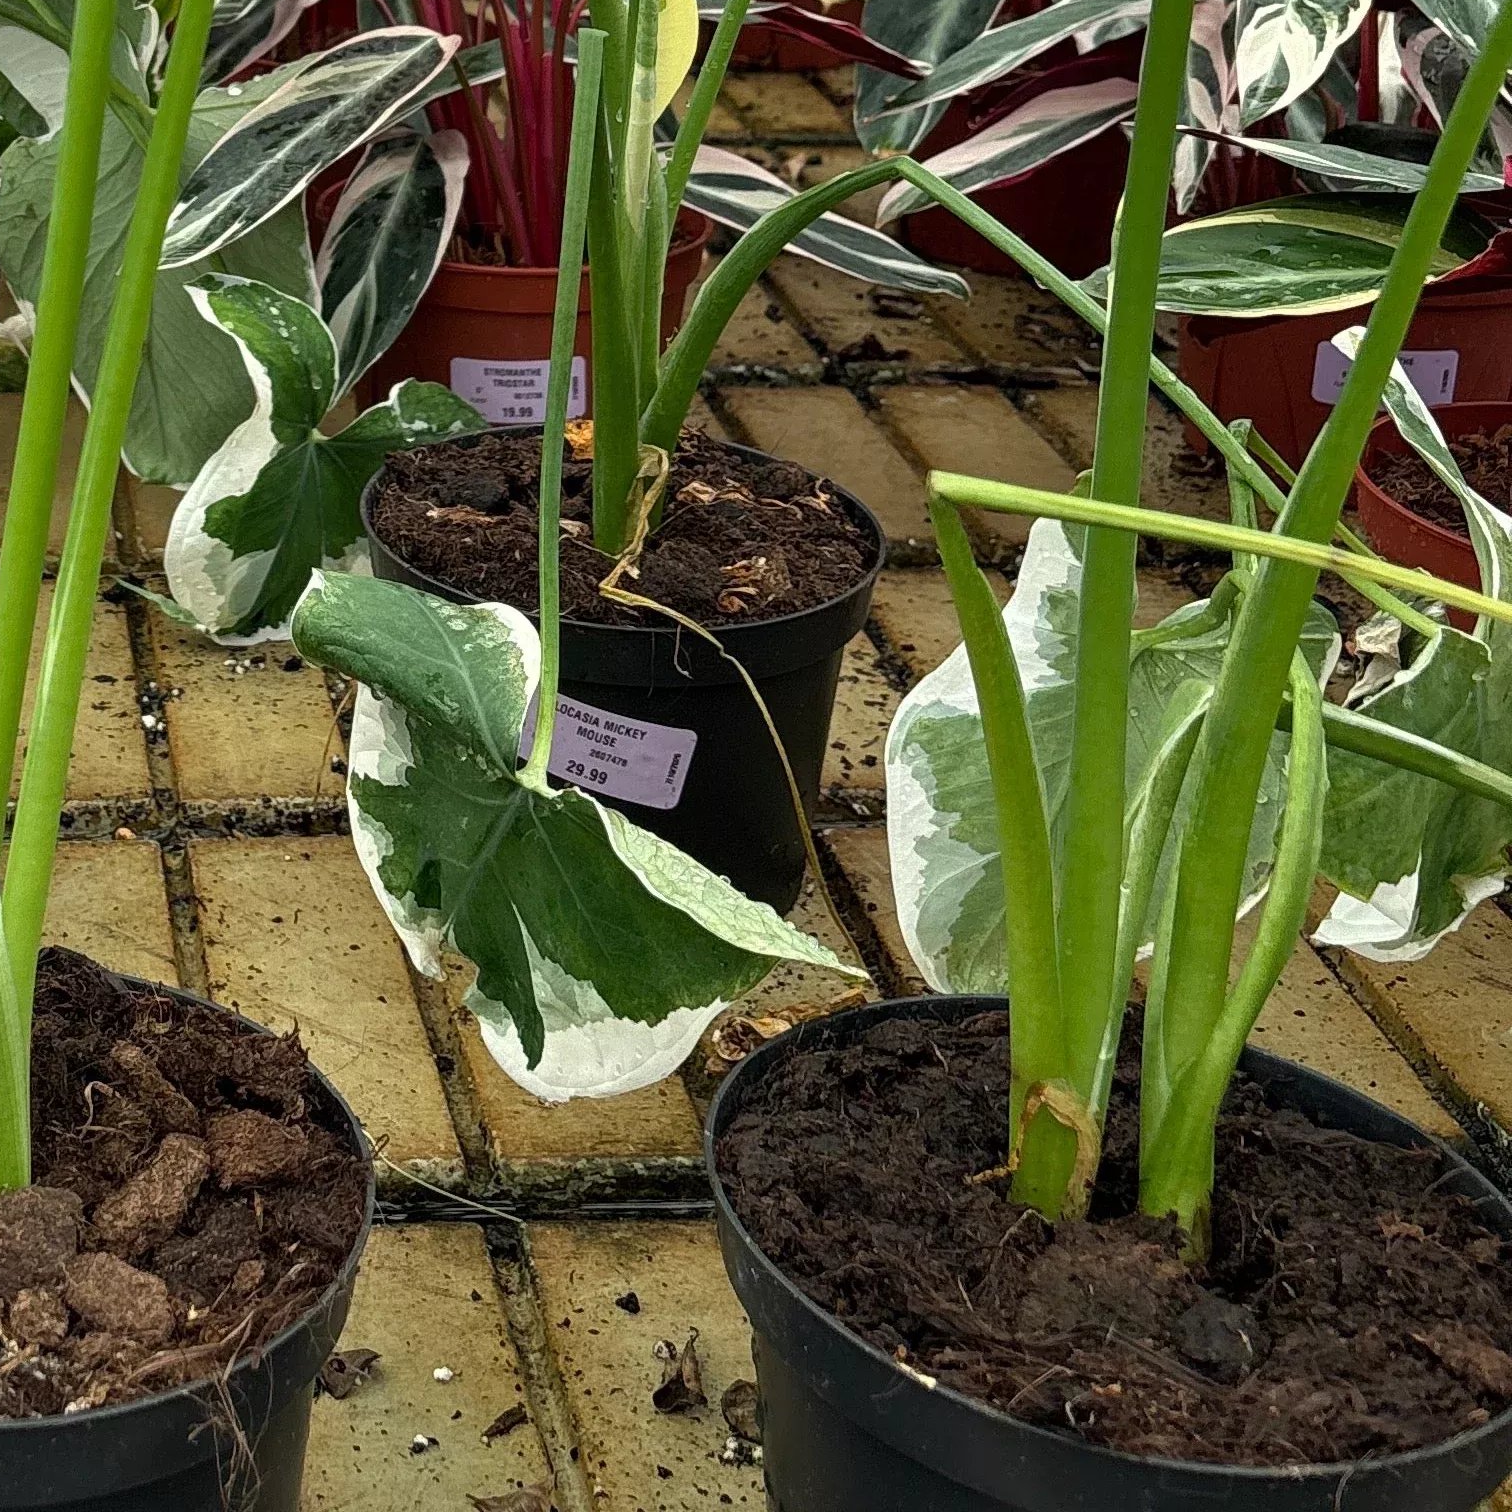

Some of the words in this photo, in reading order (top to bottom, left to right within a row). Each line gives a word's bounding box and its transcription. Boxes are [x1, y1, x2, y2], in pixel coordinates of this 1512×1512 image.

[502, 406, 534, 418] 19.99
[555, 699, 600, 727] LOCASIA
[603, 720, 648, 741] MICKEY
[576, 725, 618, 748] MOUSE
[565, 759, 608, 785] 29.99
